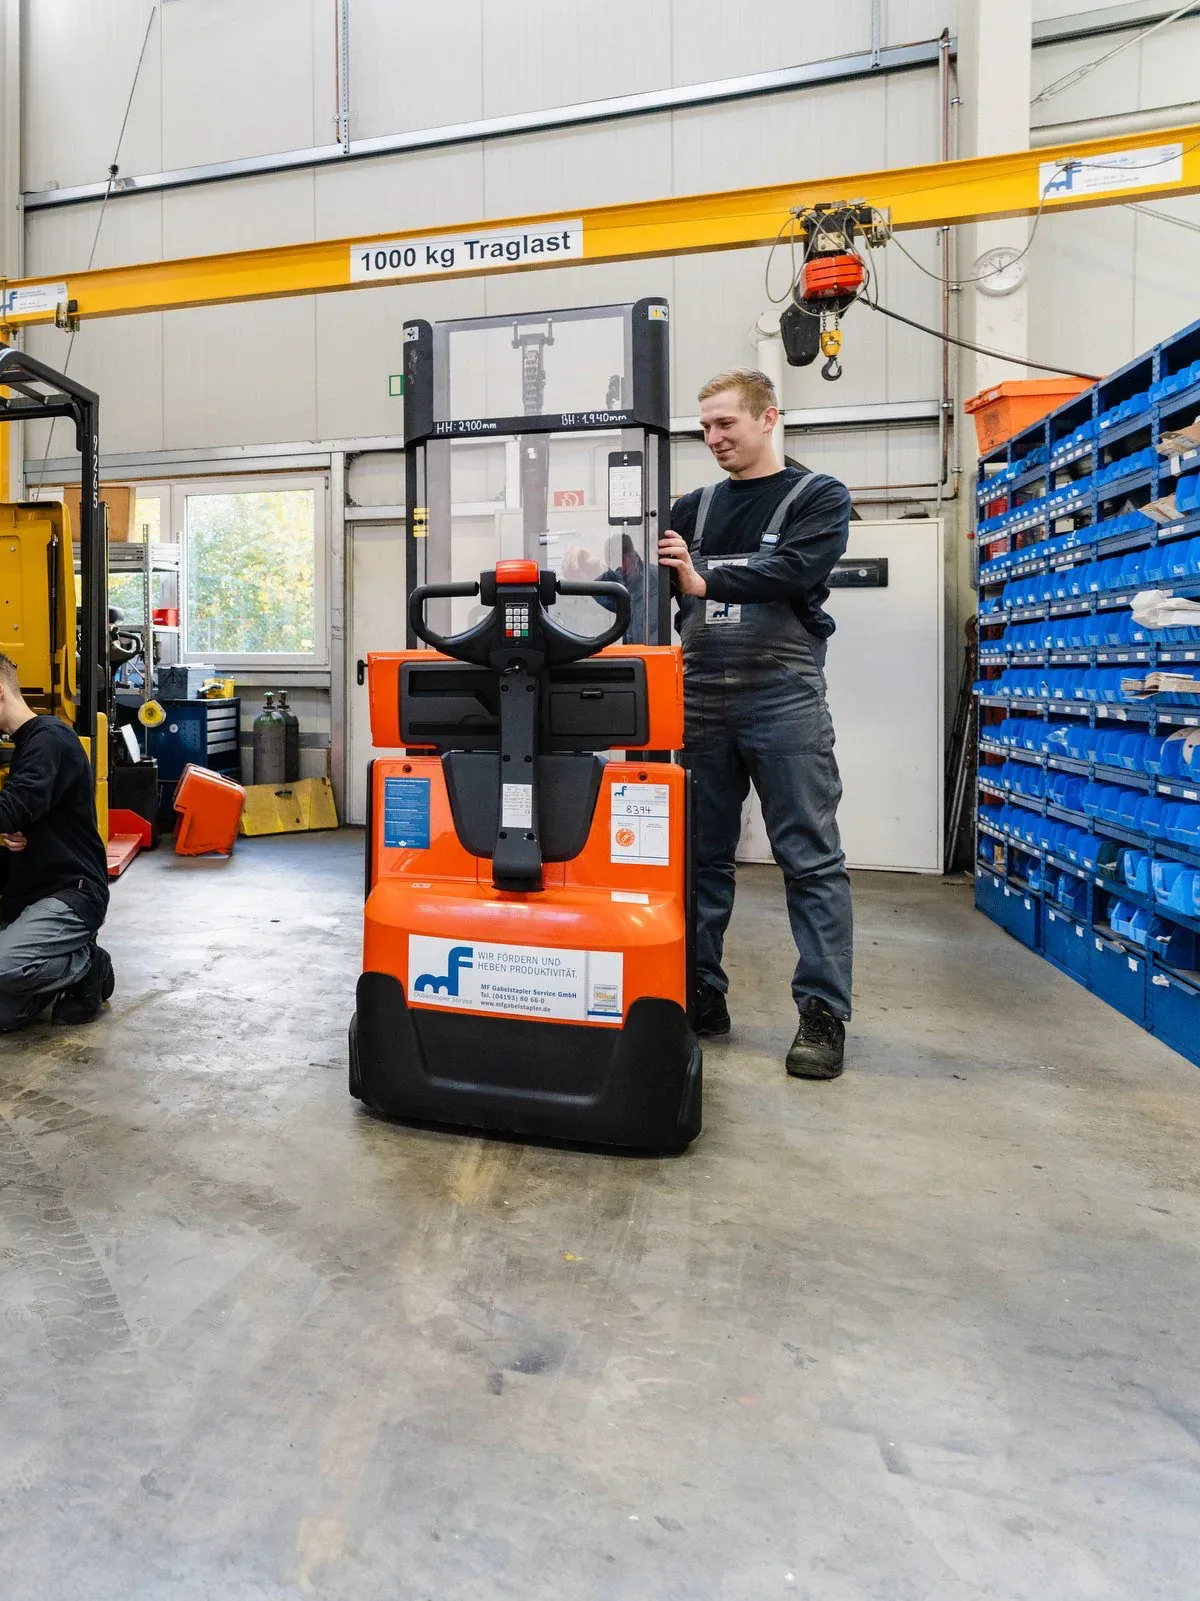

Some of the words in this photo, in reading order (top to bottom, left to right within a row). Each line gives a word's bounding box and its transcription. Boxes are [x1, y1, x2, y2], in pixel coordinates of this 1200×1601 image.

[361, 247, 417, 272] 1000
[425, 245, 455, 268] kg
[463, 231, 571, 261] Traglast
[91, 434, 99, 509] 9265
[626, 804, 652, 815] 8394
[477, 951, 494, 961] WIR
[497, 953, 539, 965] FÖRDERN
[541, 957, 561, 967] UND
[477, 961, 507, 972] HEBEN
[492, 985, 531, 996] Gabelstapler
[533, 989, 557, 998] Service
[557, 991, 577, 999] GmbH
[492, 993, 519, 1002] (04193)
[451, 996, 473, 1005] Service
[480, 1000, 552, 1013] www.mfgabelstapler.de
